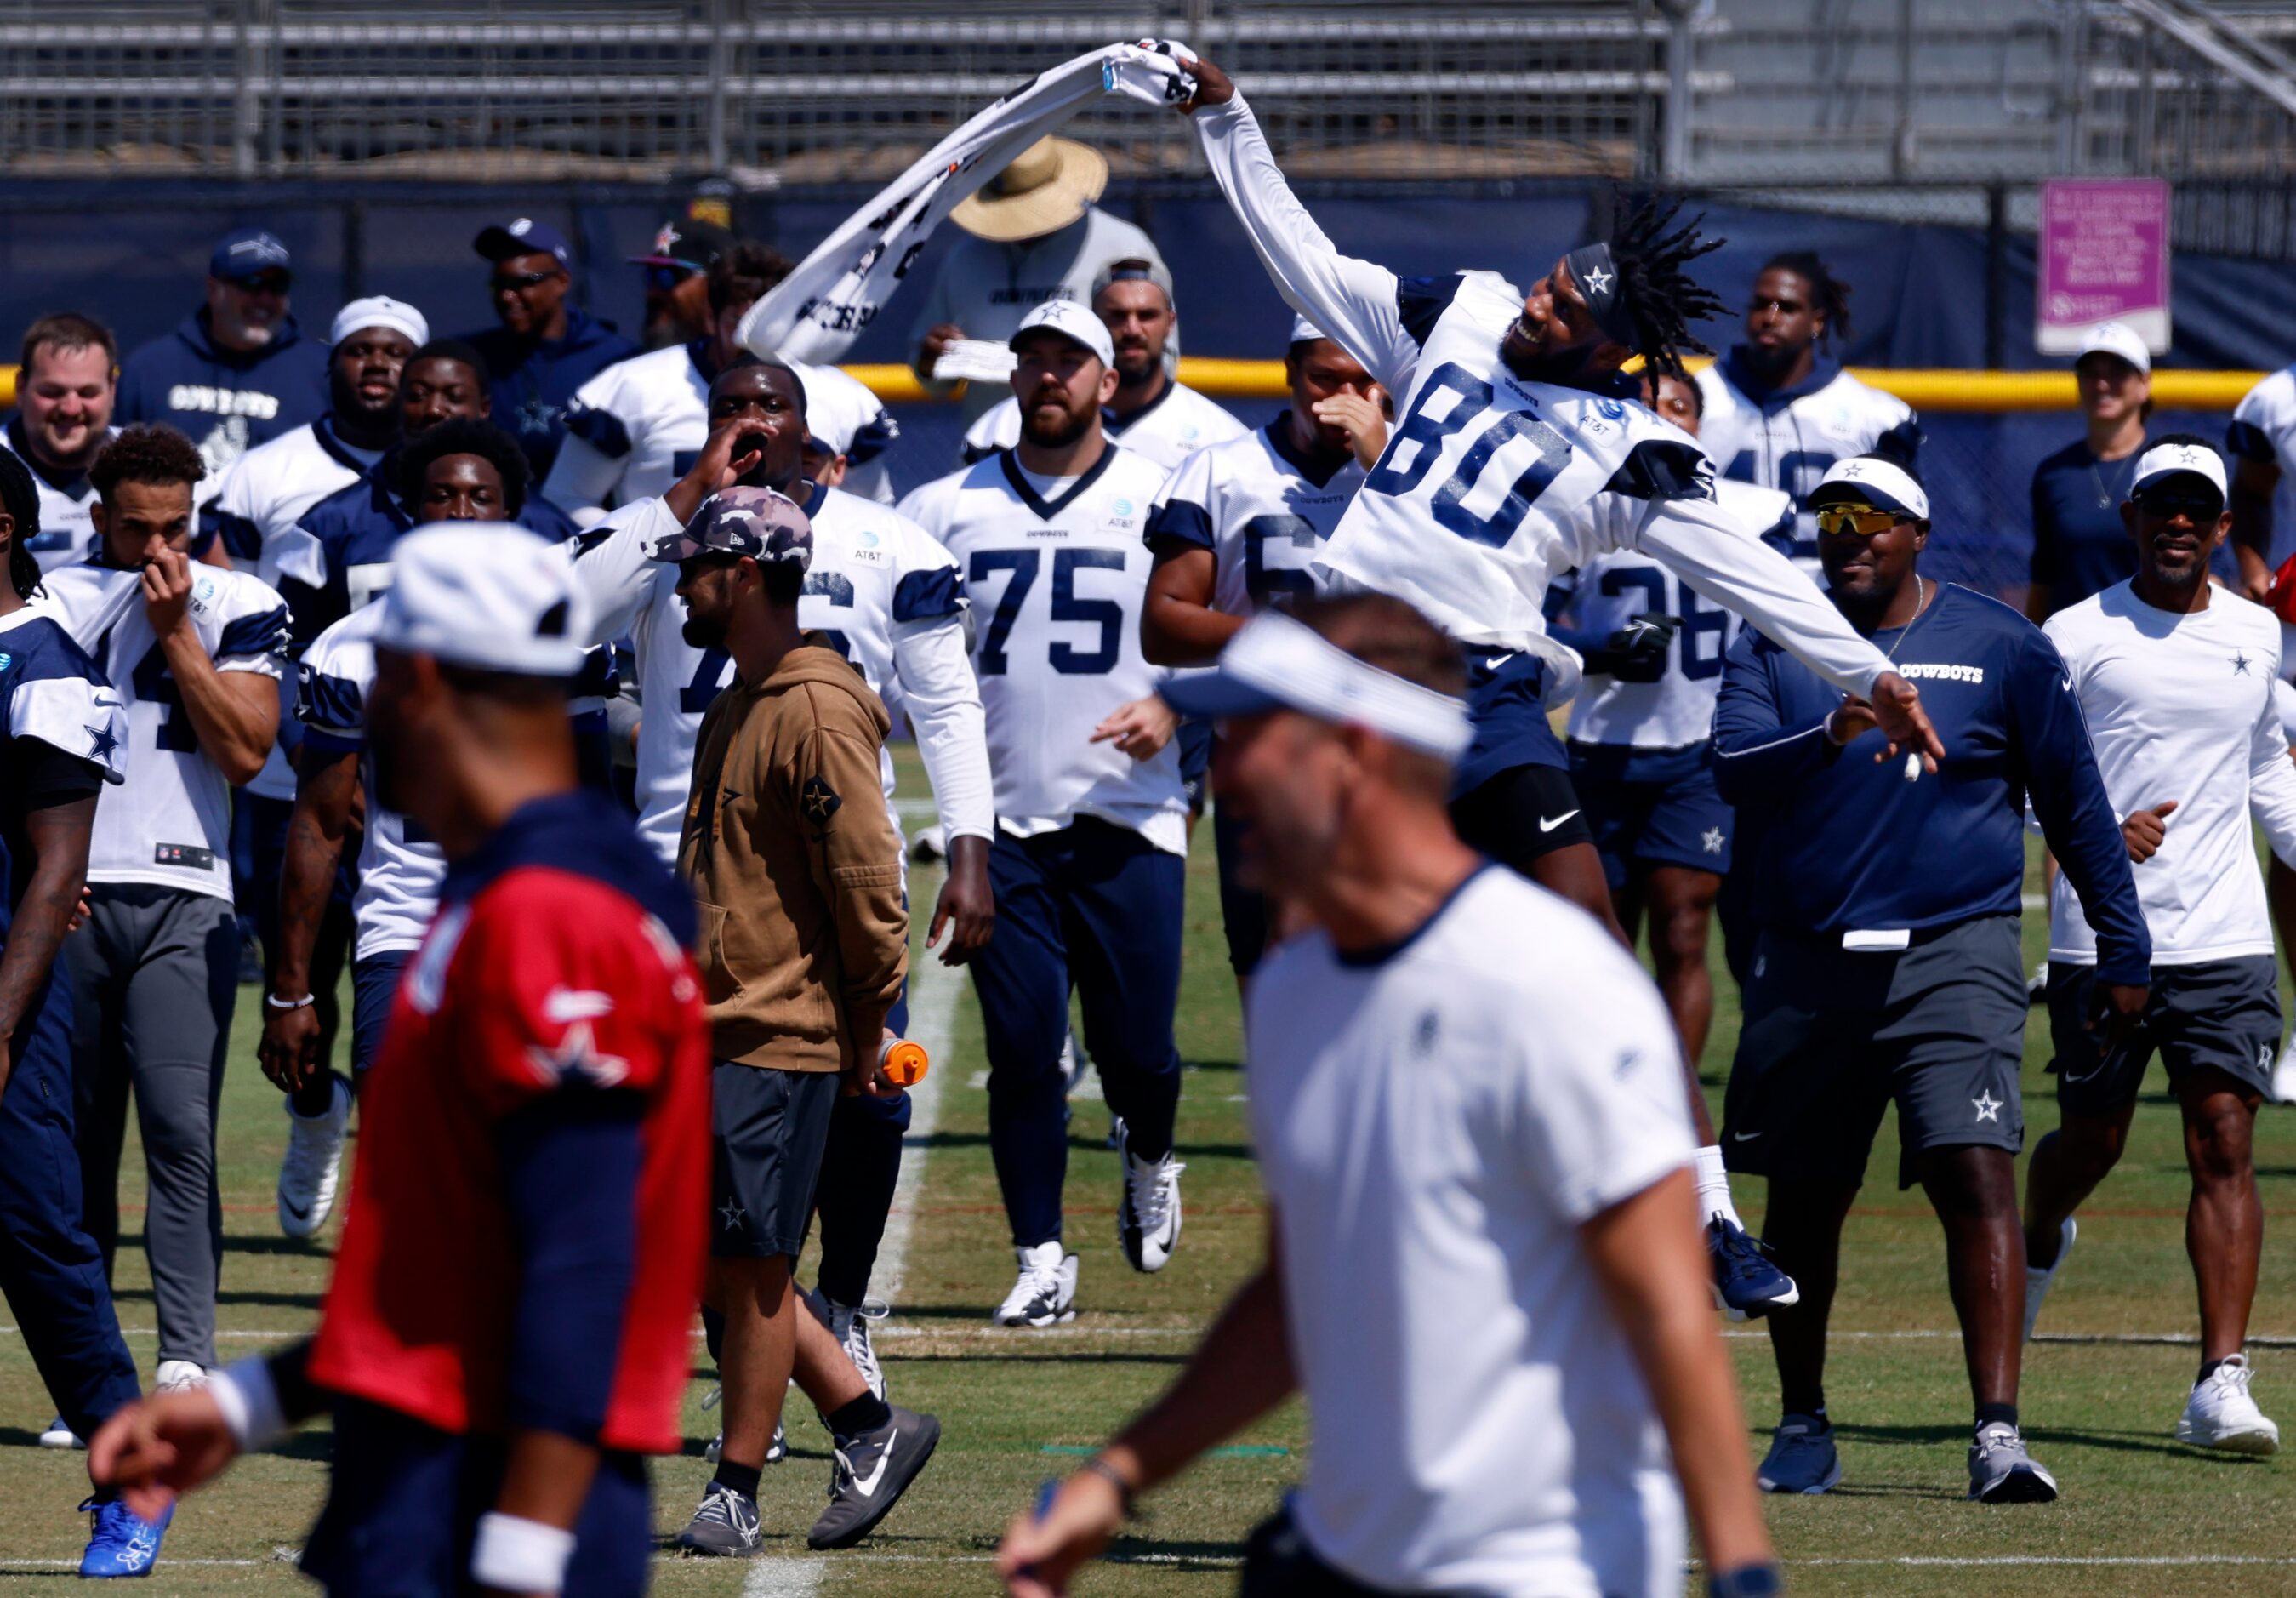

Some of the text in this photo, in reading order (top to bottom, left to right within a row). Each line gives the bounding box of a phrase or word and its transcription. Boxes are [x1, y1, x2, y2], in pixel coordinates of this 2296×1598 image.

[1580, 415, 1610, 436] AT&T
[1364, 361, 1572, 549] 80
[1300, 494, 1345, 505] COWBOYS
[1109, 518, 1135, 529] AT&T
[855, 550, 882, 562] AT&T
[189, 597, 209, 614] T&T
[970, 548, 1126, 675] 75
[1899, 664, 1984, 684] COWBOYS
